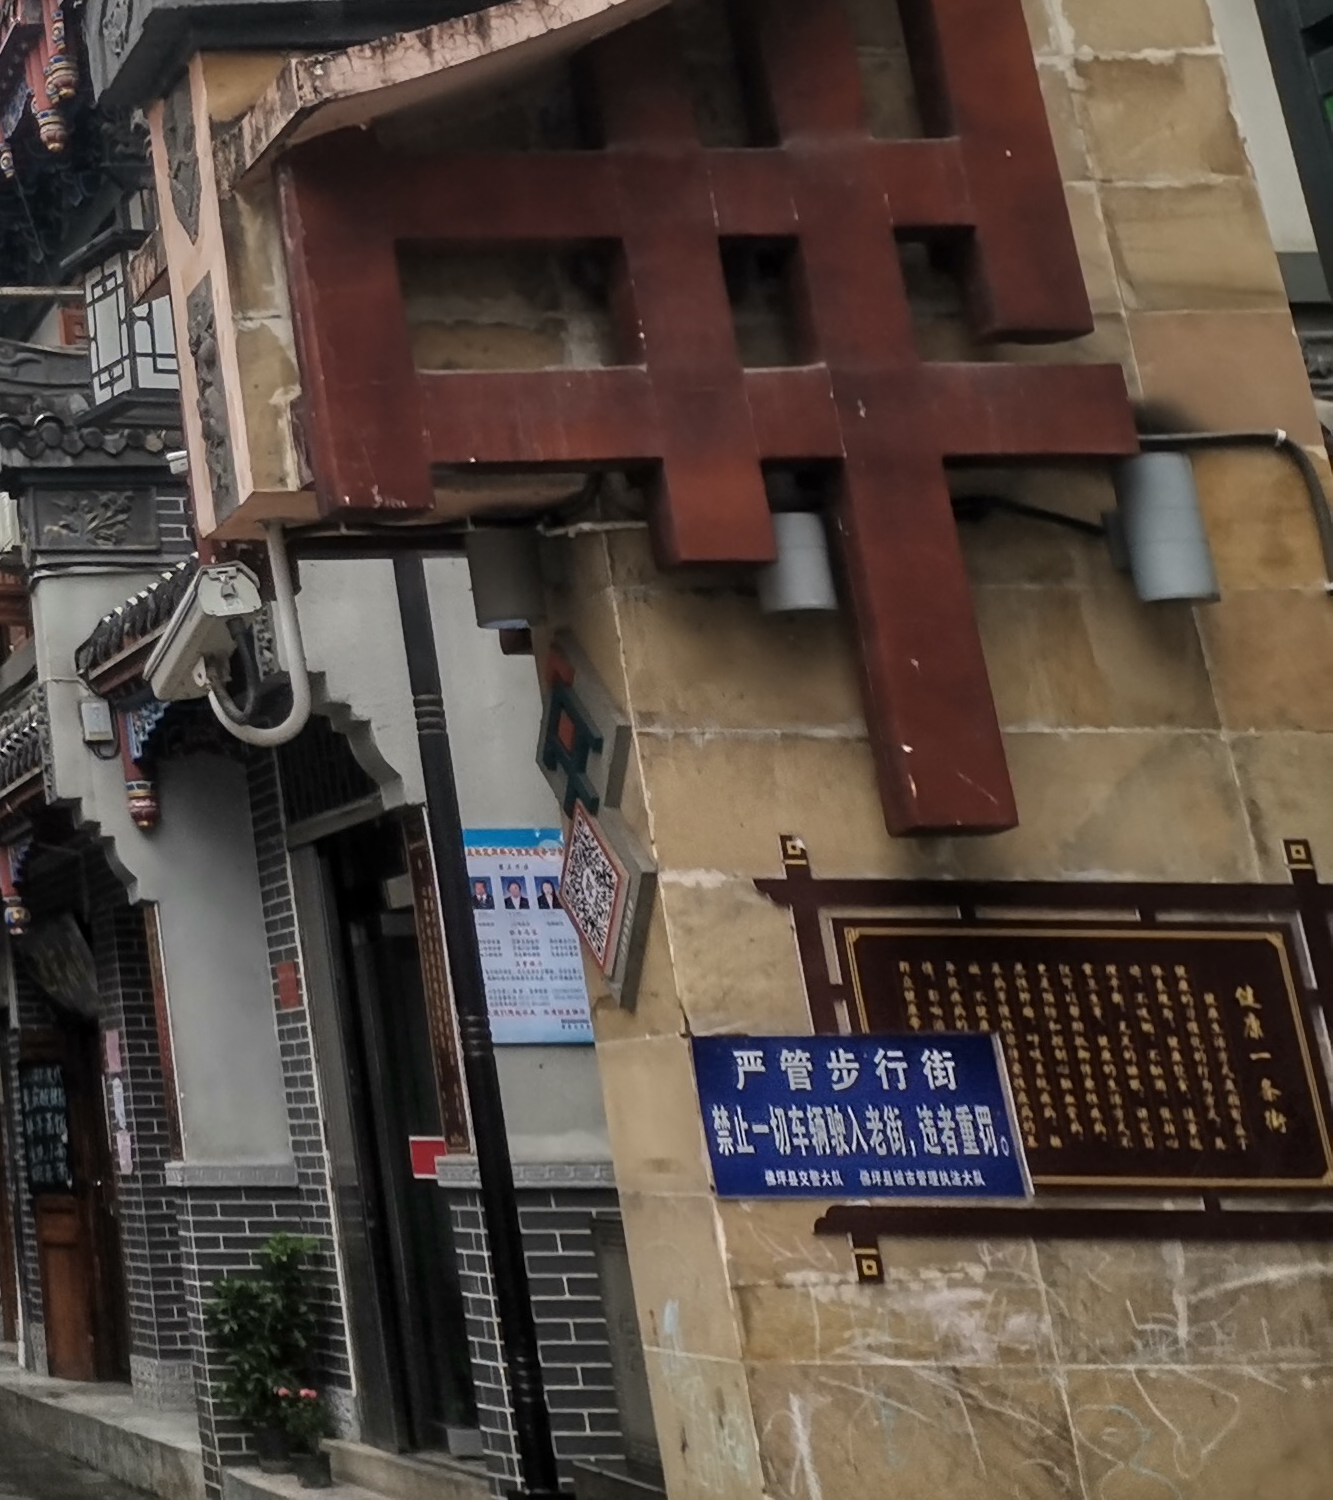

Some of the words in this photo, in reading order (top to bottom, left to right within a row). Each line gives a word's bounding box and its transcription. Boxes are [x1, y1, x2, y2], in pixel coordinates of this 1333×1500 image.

[733, 1048, 958, 1091] 严管步行街
[1235, 983, 1288, 1134] 健康一条街
